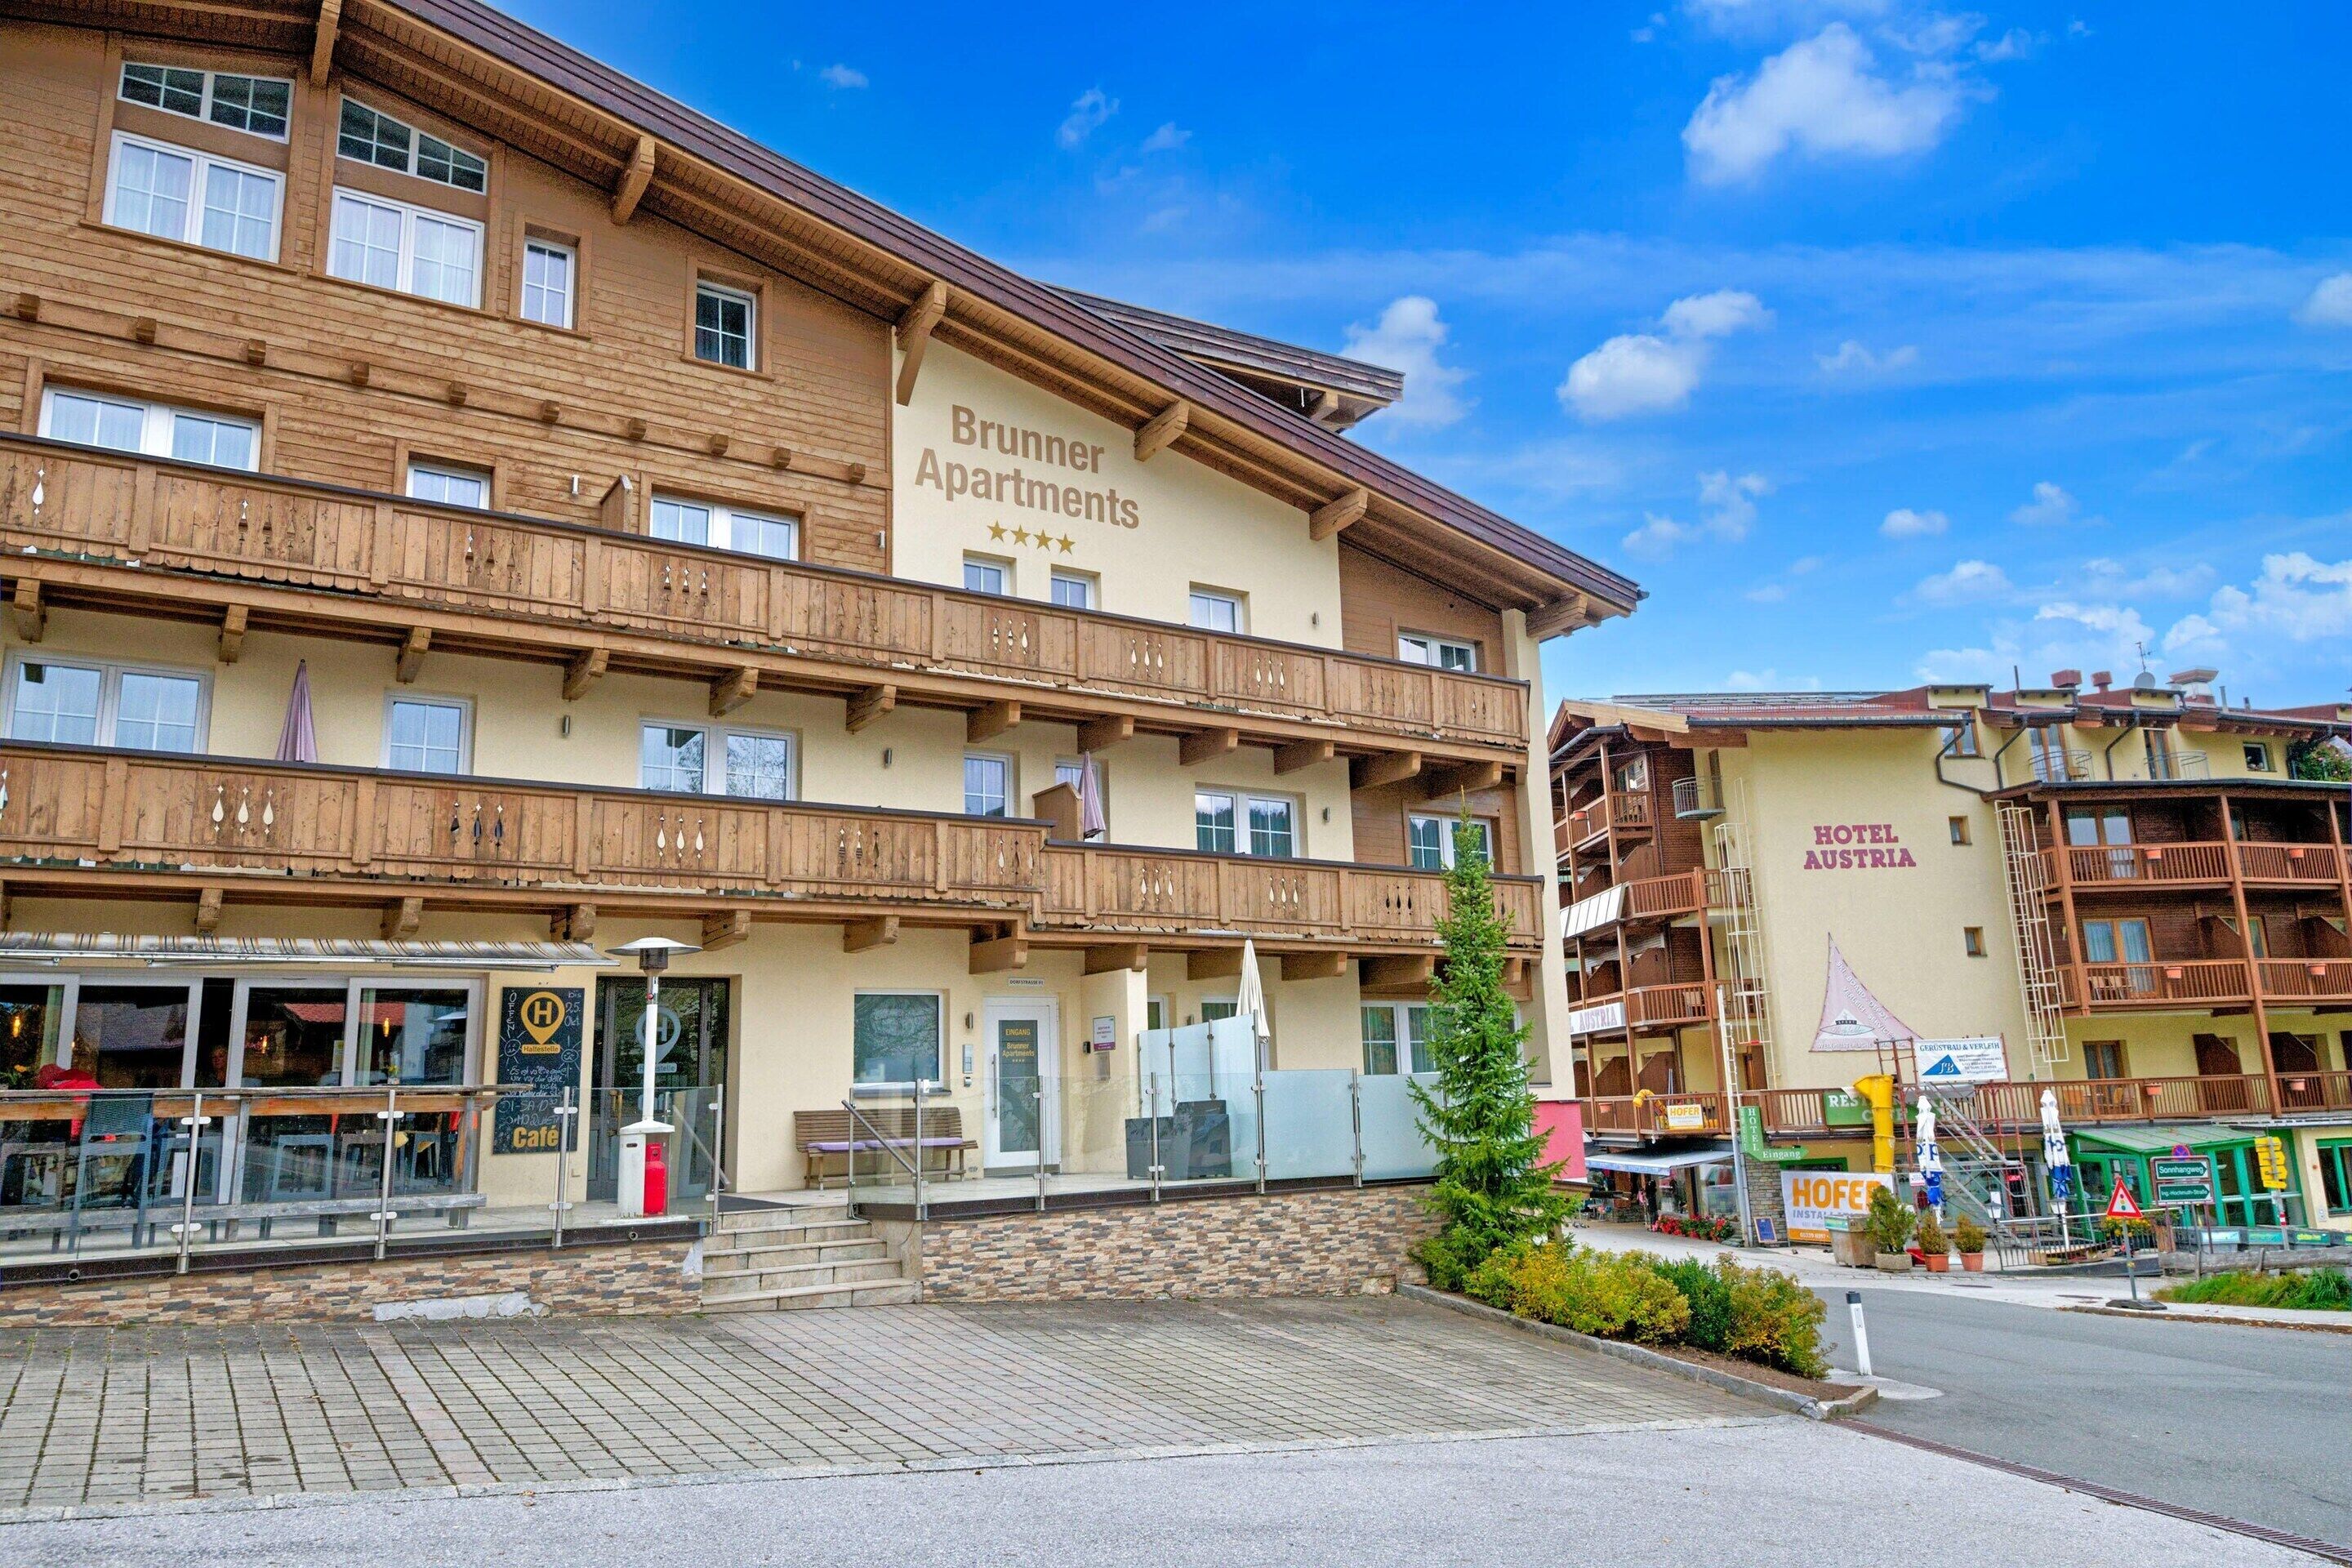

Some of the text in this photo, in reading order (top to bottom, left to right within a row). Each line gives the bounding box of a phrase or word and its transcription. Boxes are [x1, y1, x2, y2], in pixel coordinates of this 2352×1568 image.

[951, 403, 1105, 474] Brunner
[915, 447, 1139, 529] Apartments
[1813, 823, 1899, 845] HOTEL
[1803, 848, 1917, 870] AUSTRIA
[533, 1001, 552, 1025] H
[1579, 1004, 1617, 1032] AUSTRIA
[1002, 1049, 1035, 1058] Apartments
[1970, 1042, 2000, 1050] VERLEIH
[1670, 1107, 1699, 1116] HOFER
[513, 1125, 559, 1148] Café
[1748, 1107, 1760, 1152] HOTEL
[1762, 1150, 1802, 1160] Eingang
[2158, 1165, 2204, 1174] Sonnhangweg
